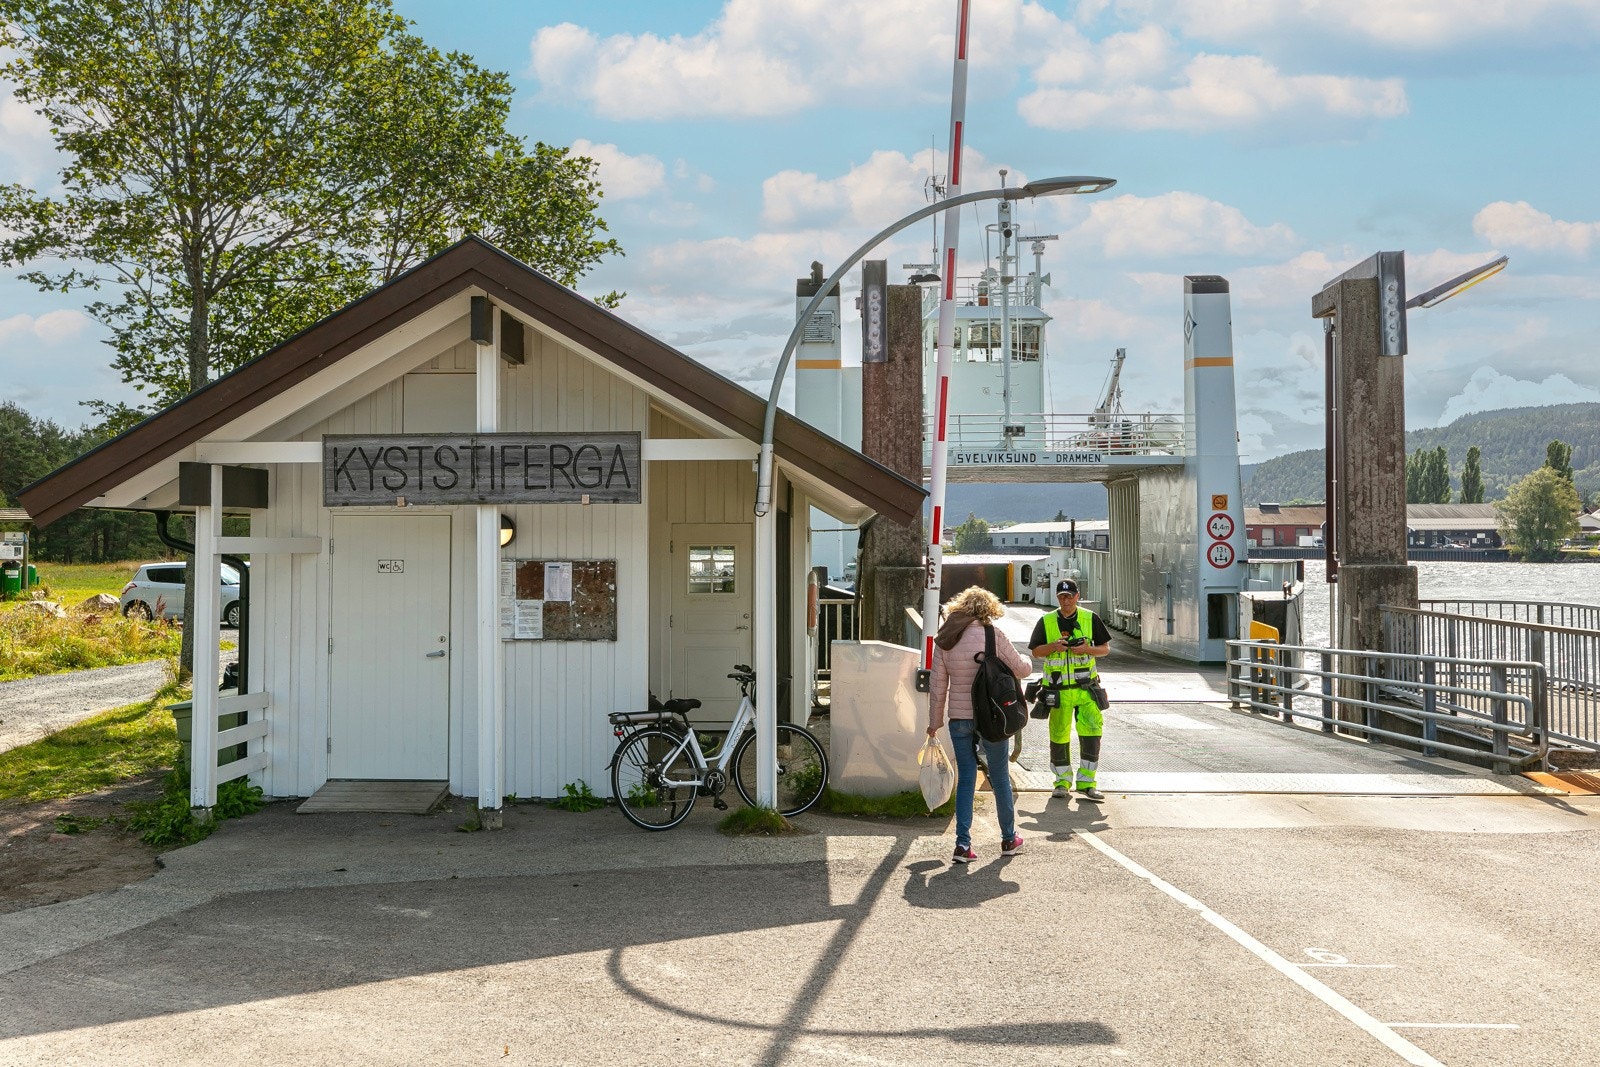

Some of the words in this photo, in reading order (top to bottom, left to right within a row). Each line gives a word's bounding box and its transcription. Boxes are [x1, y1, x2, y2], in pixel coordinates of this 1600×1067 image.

[957, 453, 1037, 464] SVELVIKSUND
[1056, 453, 1102, 463] DRAMMEN
[333, 443, 632, 492] KYSTSTIFERGA
[1303, 948, 1349, 964] 6
